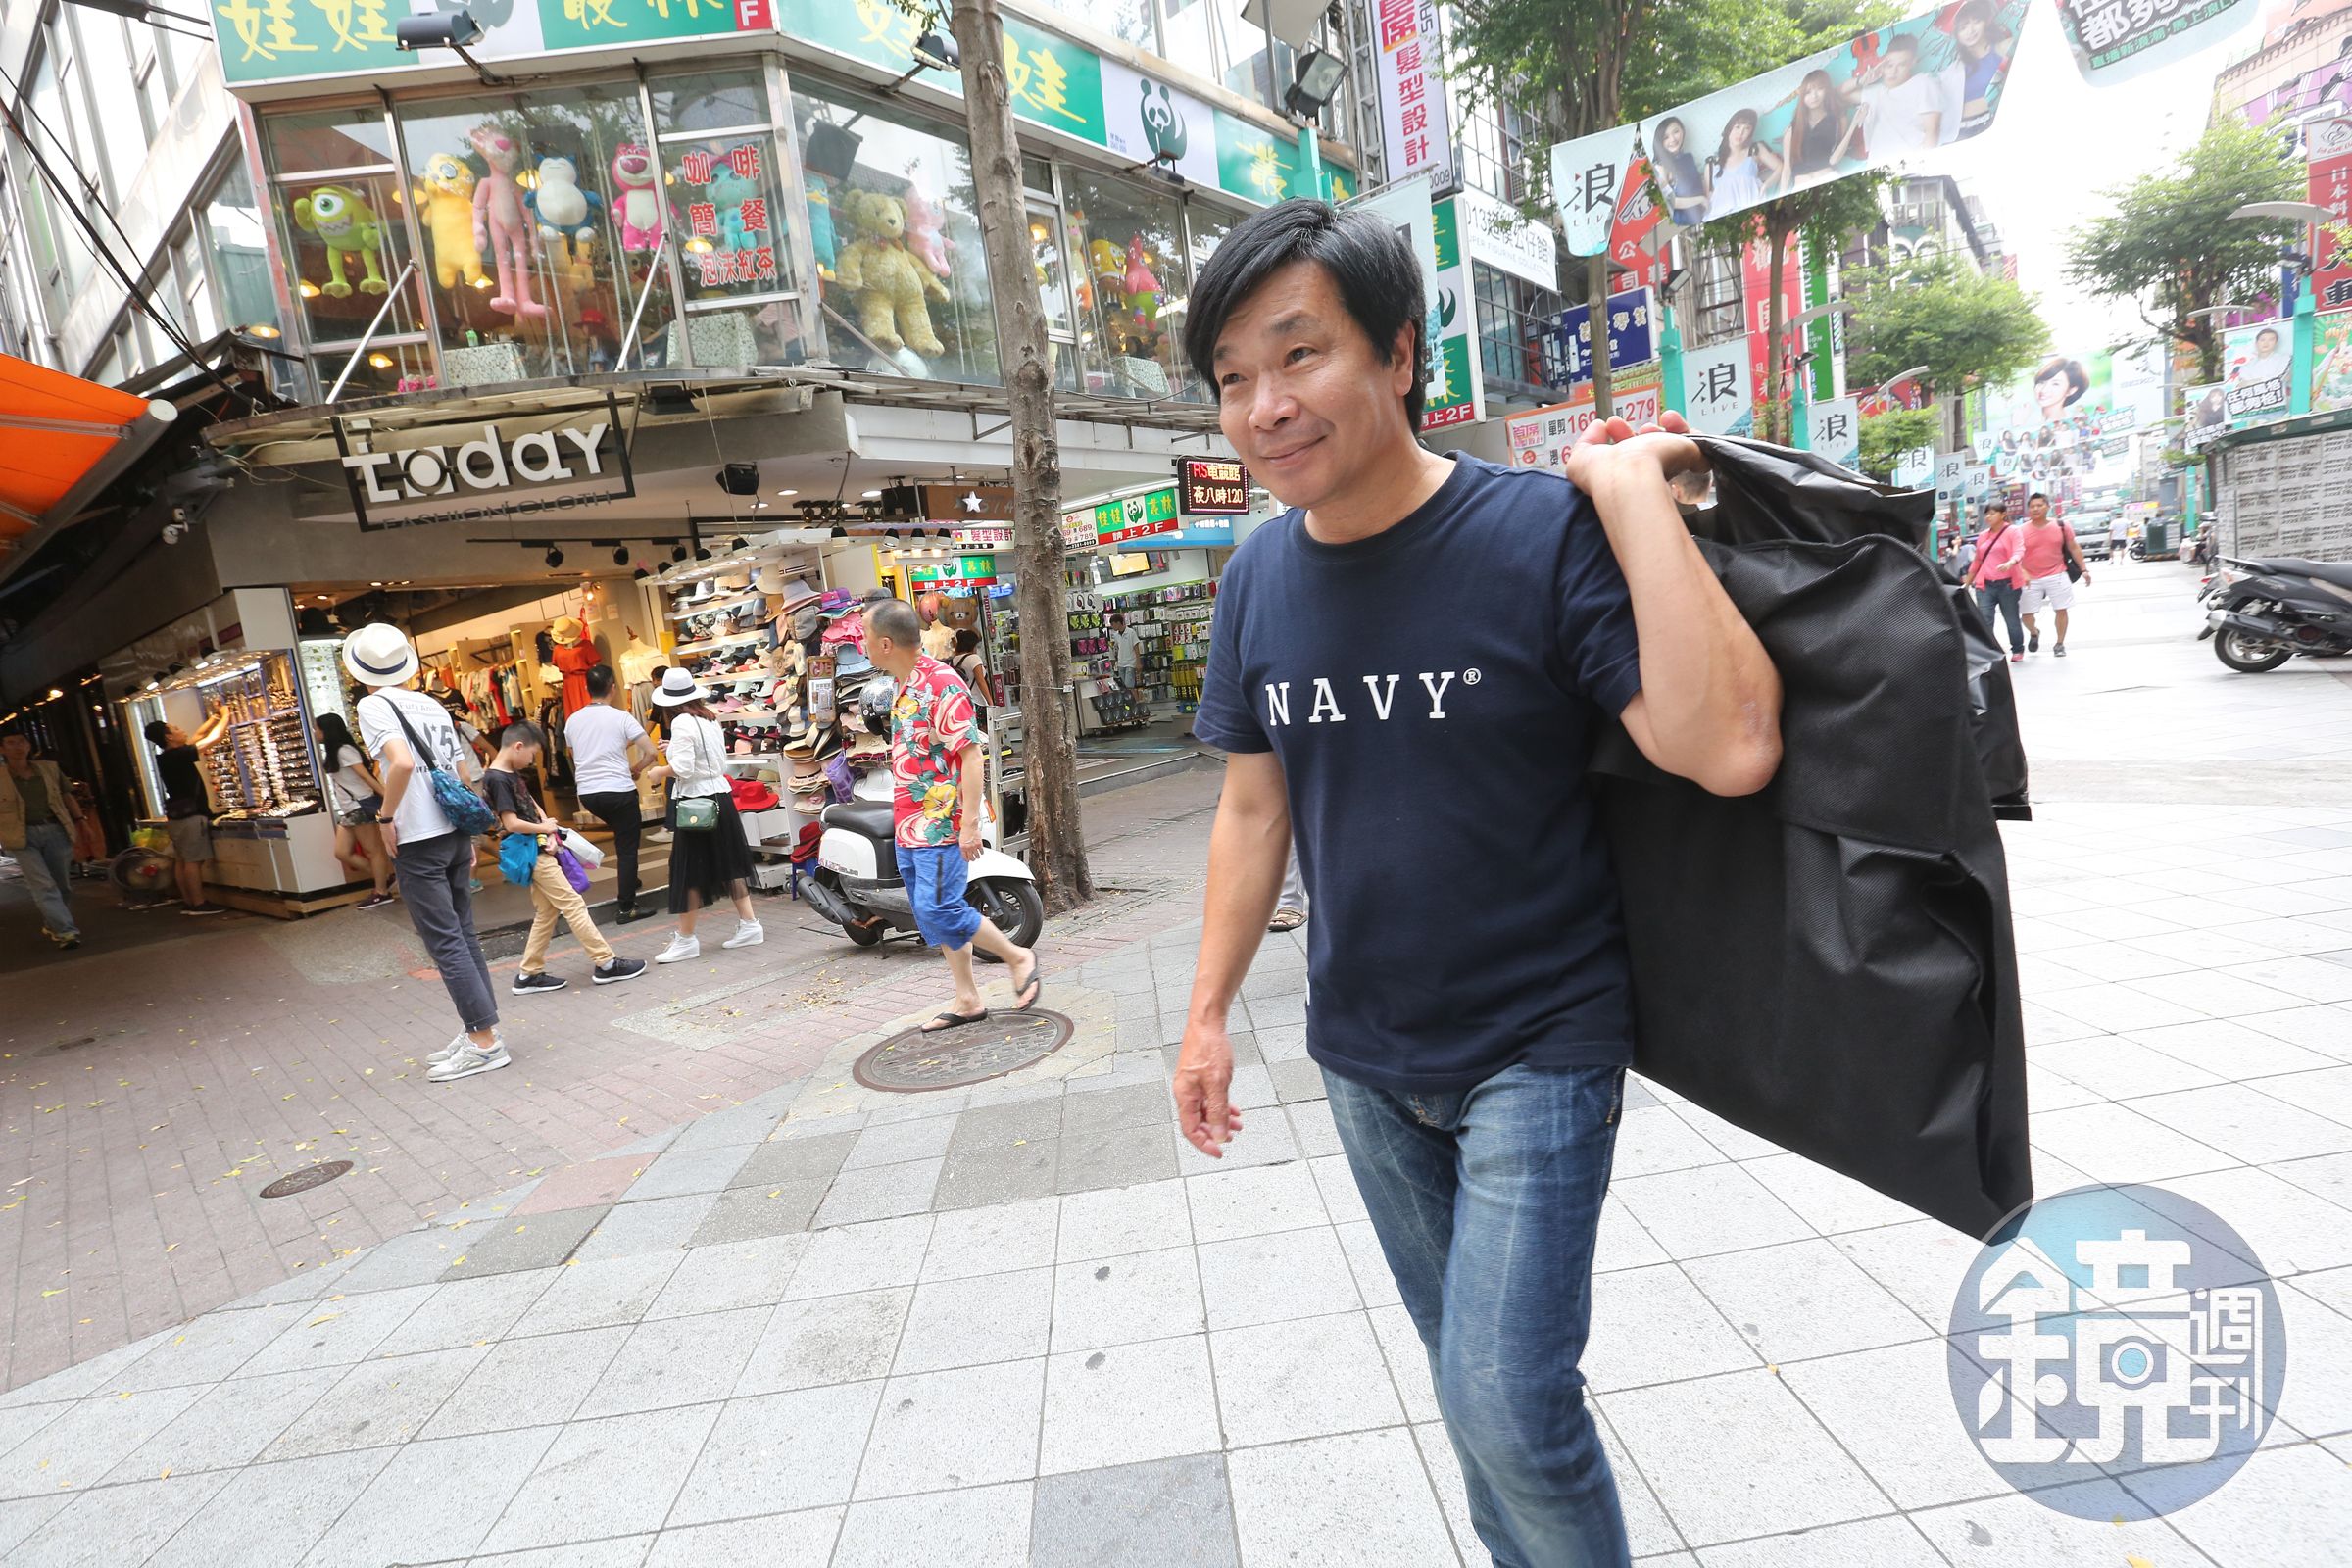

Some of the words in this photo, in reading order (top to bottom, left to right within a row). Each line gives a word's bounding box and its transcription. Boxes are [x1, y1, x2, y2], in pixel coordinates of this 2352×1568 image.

[1396, 42, 1429, 166] 髮型設計
[682, 145, 760, 185] 咖啡
[1563, 163, 1616, 214] 浪
[689, 199, 768, 236] 簡餐
[1573, 214, 1605, 227] LIV
[700, 247, 777, 286] 泡沫紅茶
[1691, 363, 1738, 404] 浪
[1625, 398, 1655, 422] 279
[1701, 401, 1739, 416] LIVE
[1548, 419, 1566, 436] 單剪
[1814, 414, 1848, 442] 浪
[342, 423, 610, 503] today
[1148, 494, 1174, 516] 叢林
[1193, 484, 1244, 505] 夜八時120
[382, 500, 512, 531] FASHION
[516, 490, 612, 514] CLOTH
[1098, 508, 1123, 527] 娃娃
[1112, 521, 1164, 542] 請上2F
